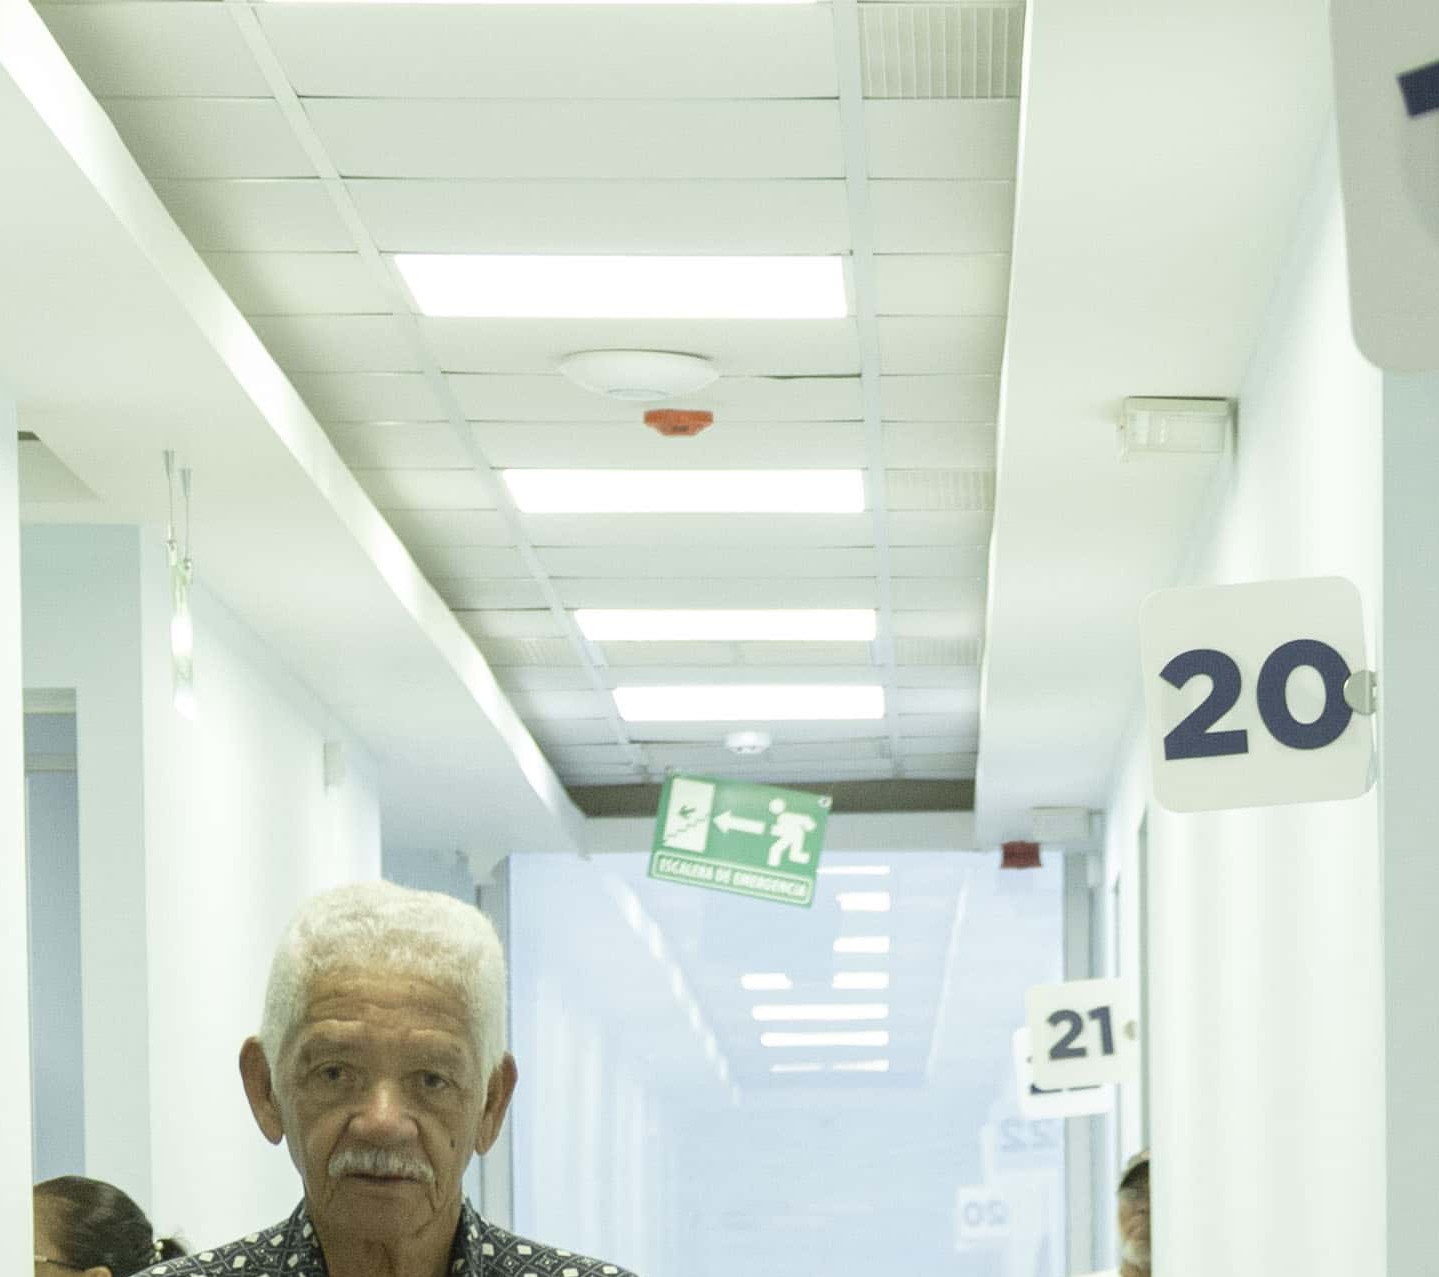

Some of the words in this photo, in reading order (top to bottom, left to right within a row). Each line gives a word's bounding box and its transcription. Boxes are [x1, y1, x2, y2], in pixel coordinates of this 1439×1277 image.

[1158, 638, 1355, 761] 20
[717, 867, 732, 884] DE
[1047, 1005, 1116, 1061] 21
